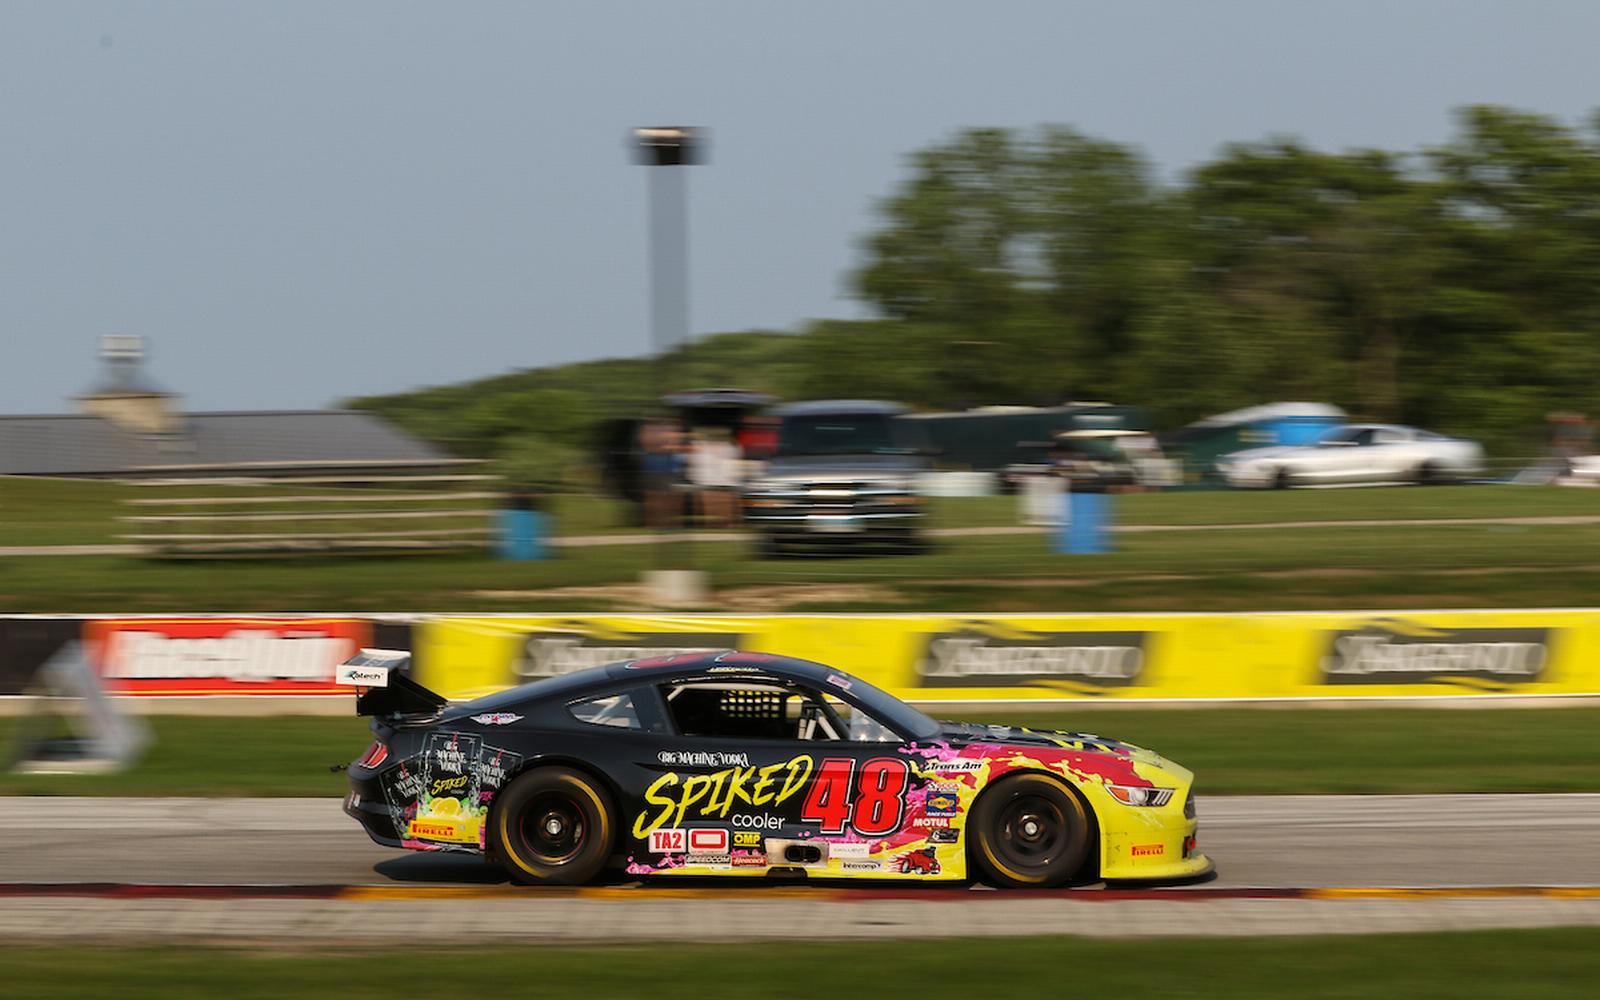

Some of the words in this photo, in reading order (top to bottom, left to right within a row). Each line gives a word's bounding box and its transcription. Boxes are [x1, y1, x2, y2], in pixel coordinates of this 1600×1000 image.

[961, 761, 982, 770] Am
[632, 755, 814, 840] SPIKED
[801, 757, 909, 837] 48
[732, 812, 785, 830] cooler
[912, 818, 949, 827] MOTUL
[412, 823, 454, 836] PIRELLI
[653, 832, 682, 849] TA2
[733, 834, 761, 844] OMP
[1132, 844, 1164, 856] PIRELLI
